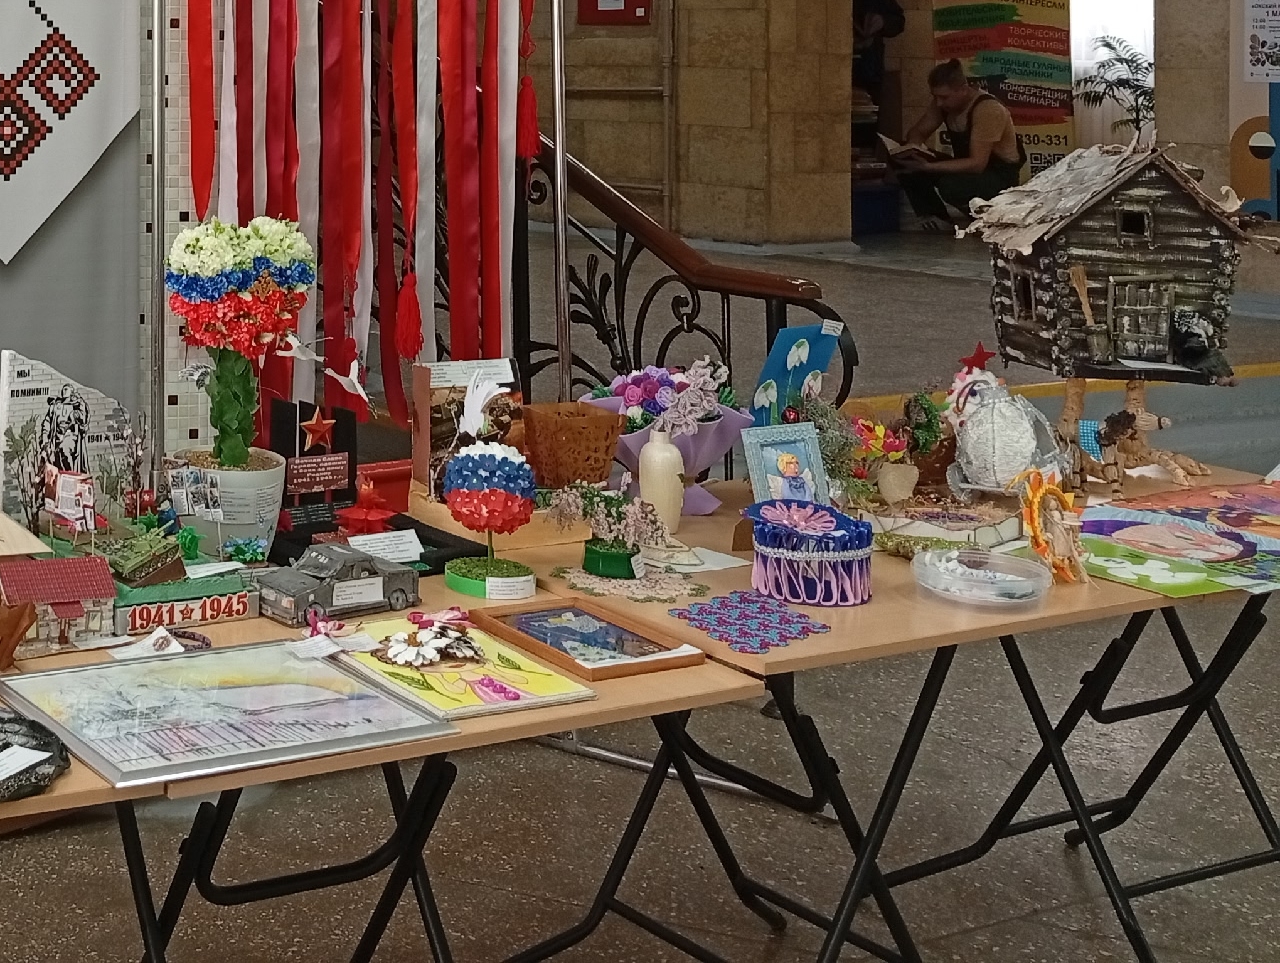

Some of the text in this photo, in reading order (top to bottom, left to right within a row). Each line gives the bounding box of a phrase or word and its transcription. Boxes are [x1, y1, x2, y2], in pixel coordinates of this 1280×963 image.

[1009, 26, 1067, 40] ТВОРЧЕСКИЕ
[1007, 37, 1067, 50] КОЛЛЕКТИВЫ
[982, 56, 1030, 69] НАРОДНЫЕ
[1000, 66, 1053, 79] ПРАЗДНИКИ
[1007, 93, 1060, 107] СЕМИНАРЫ
[16, 369, 30, 378] МЫ
[87, 434, 103, 443] 1941
[128, 592, 248, 631] 1941 1945
